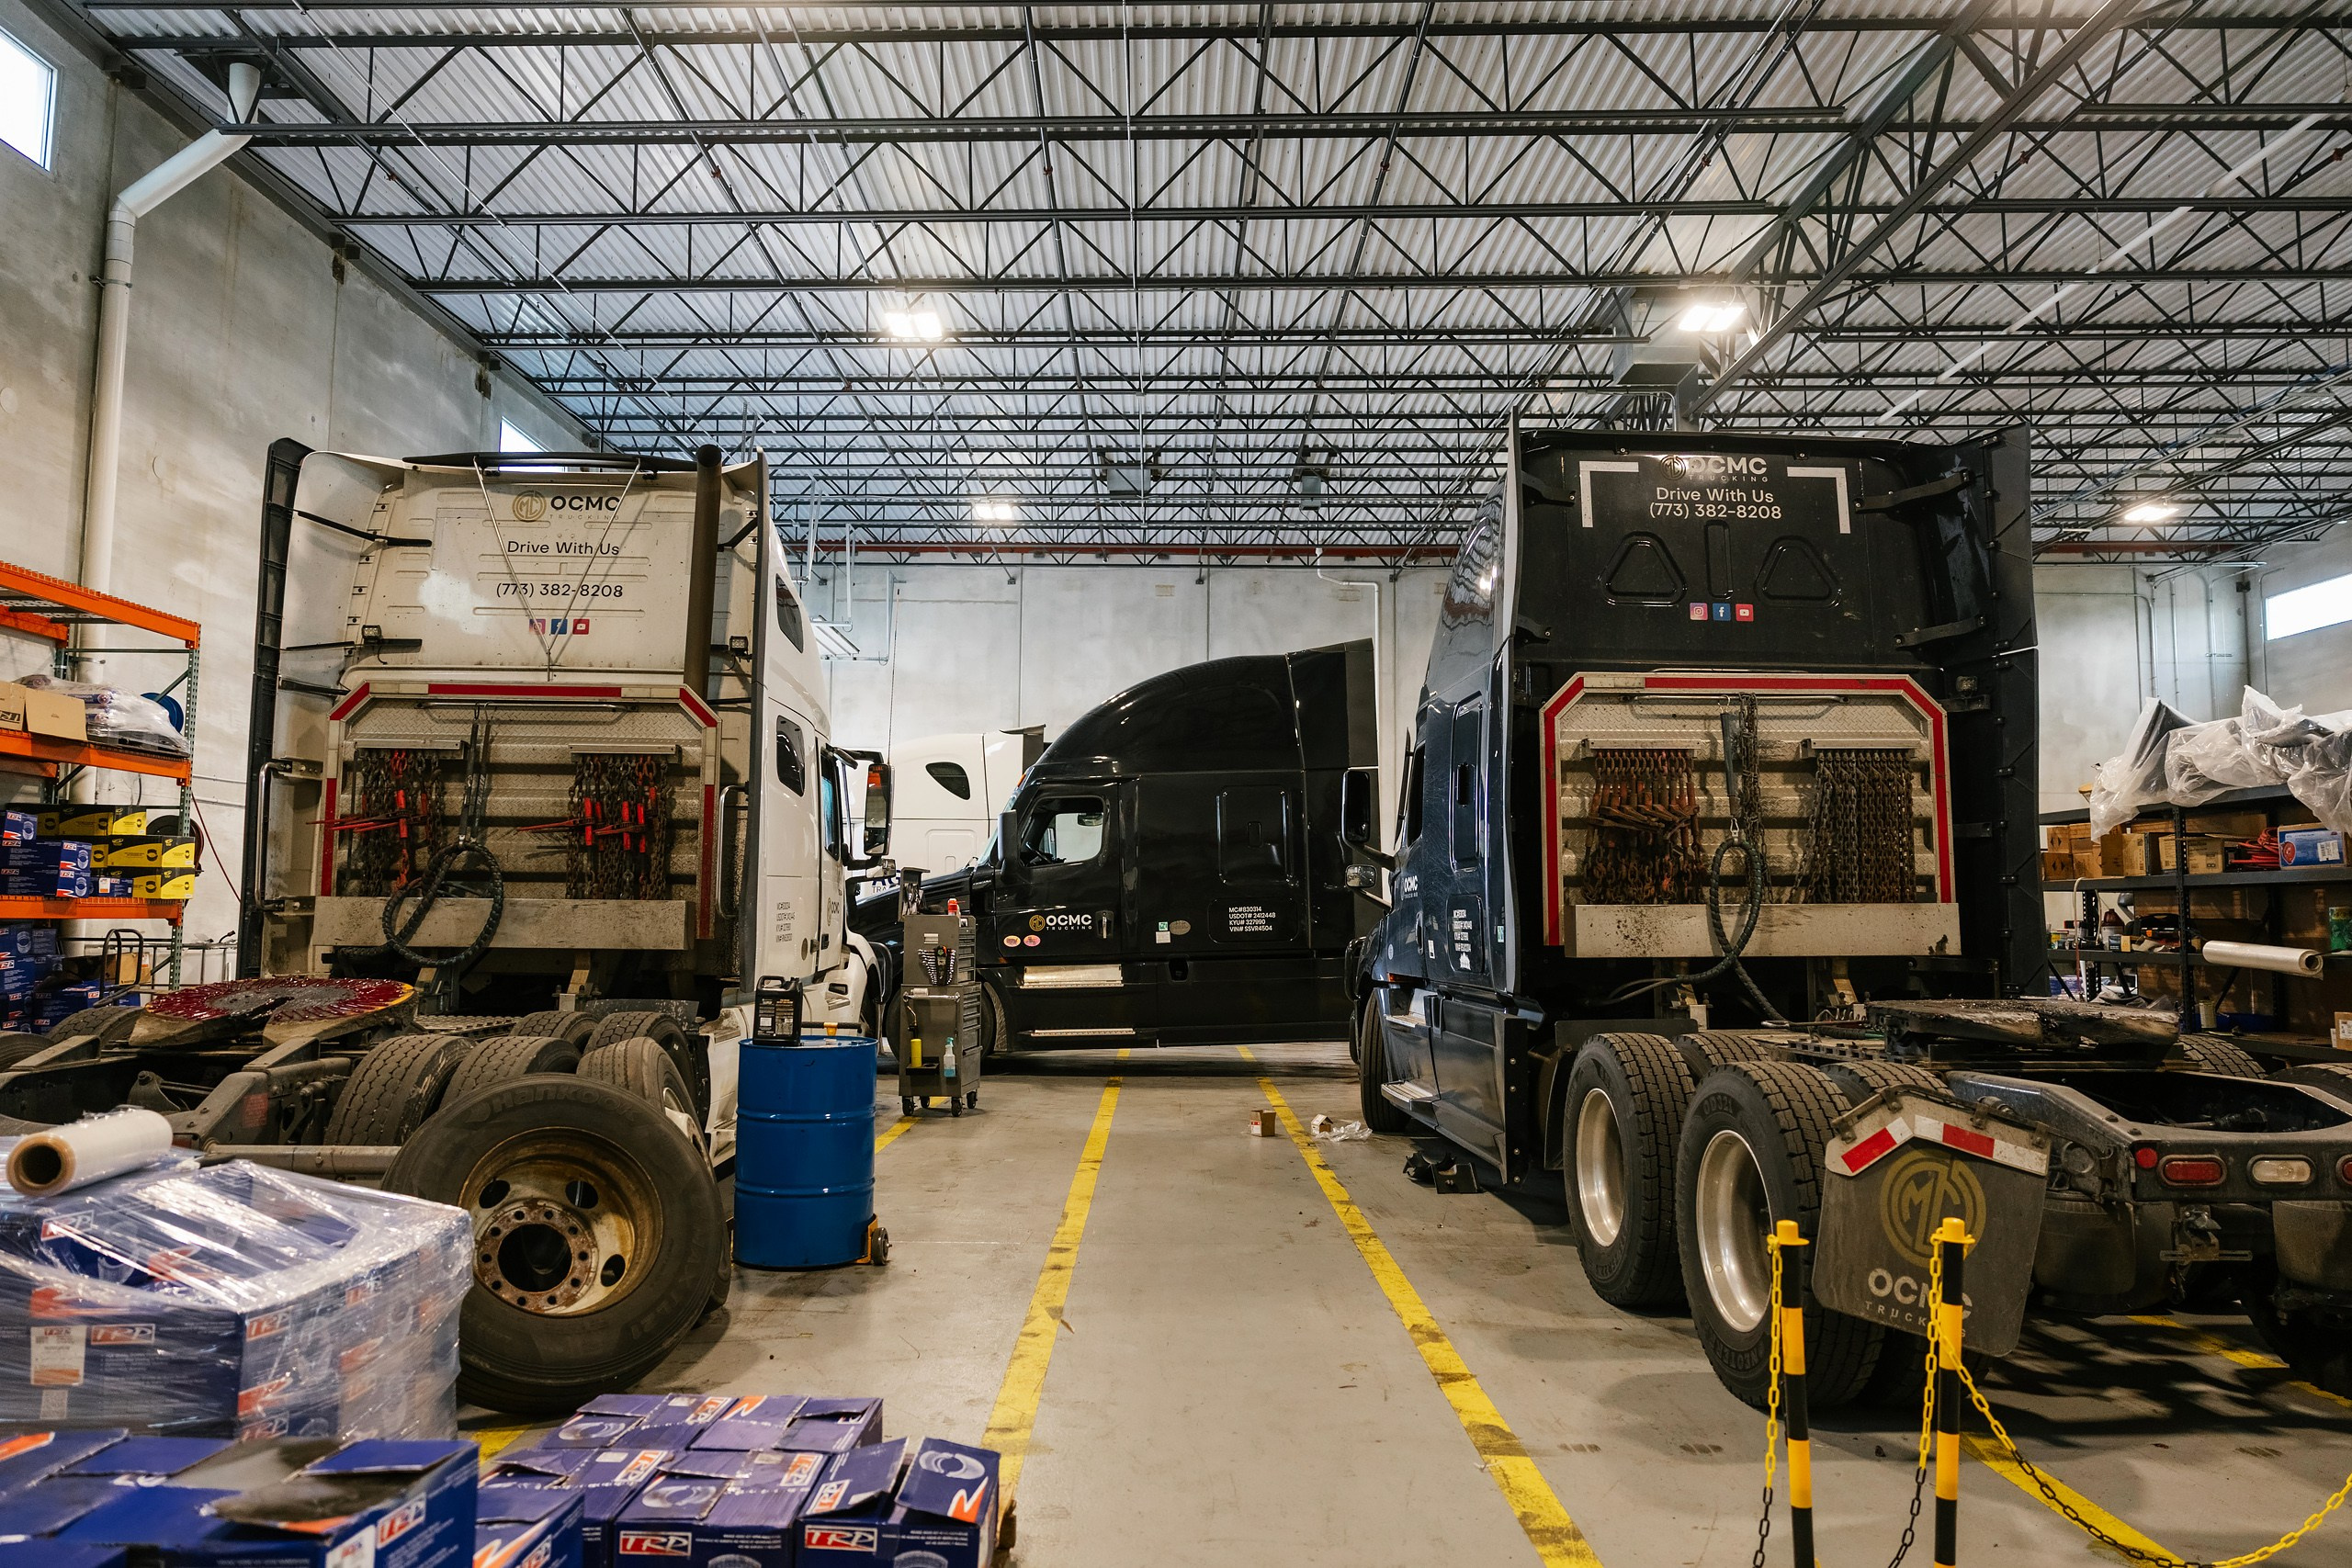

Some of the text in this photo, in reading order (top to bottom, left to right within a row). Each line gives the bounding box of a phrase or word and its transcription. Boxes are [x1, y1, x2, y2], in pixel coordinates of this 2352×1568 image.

[1689, 457, 1768, 475] OCMC
[1689, 474, 1769, 483] TRUCKING
[1656, 487, 1774, 502] Drive With Us
[550, 495, 620, 512] OCMC
[1649, 502, 1782, 519] (773) 382-8208
[507, 540, 620, 555] Drive With Us
[496, 582, 624, 598] (773) 382-8208
[1046, 914, 1092, 926] OCMC
[623, 1450, 663, 1482] TRP
[787, 1453, 820, 1485] TRP
[812, 1481, 844, 1514] TRP
[623, 1535, 690, 1552] TRP
[808, 1529, 875, 1548] TRP
